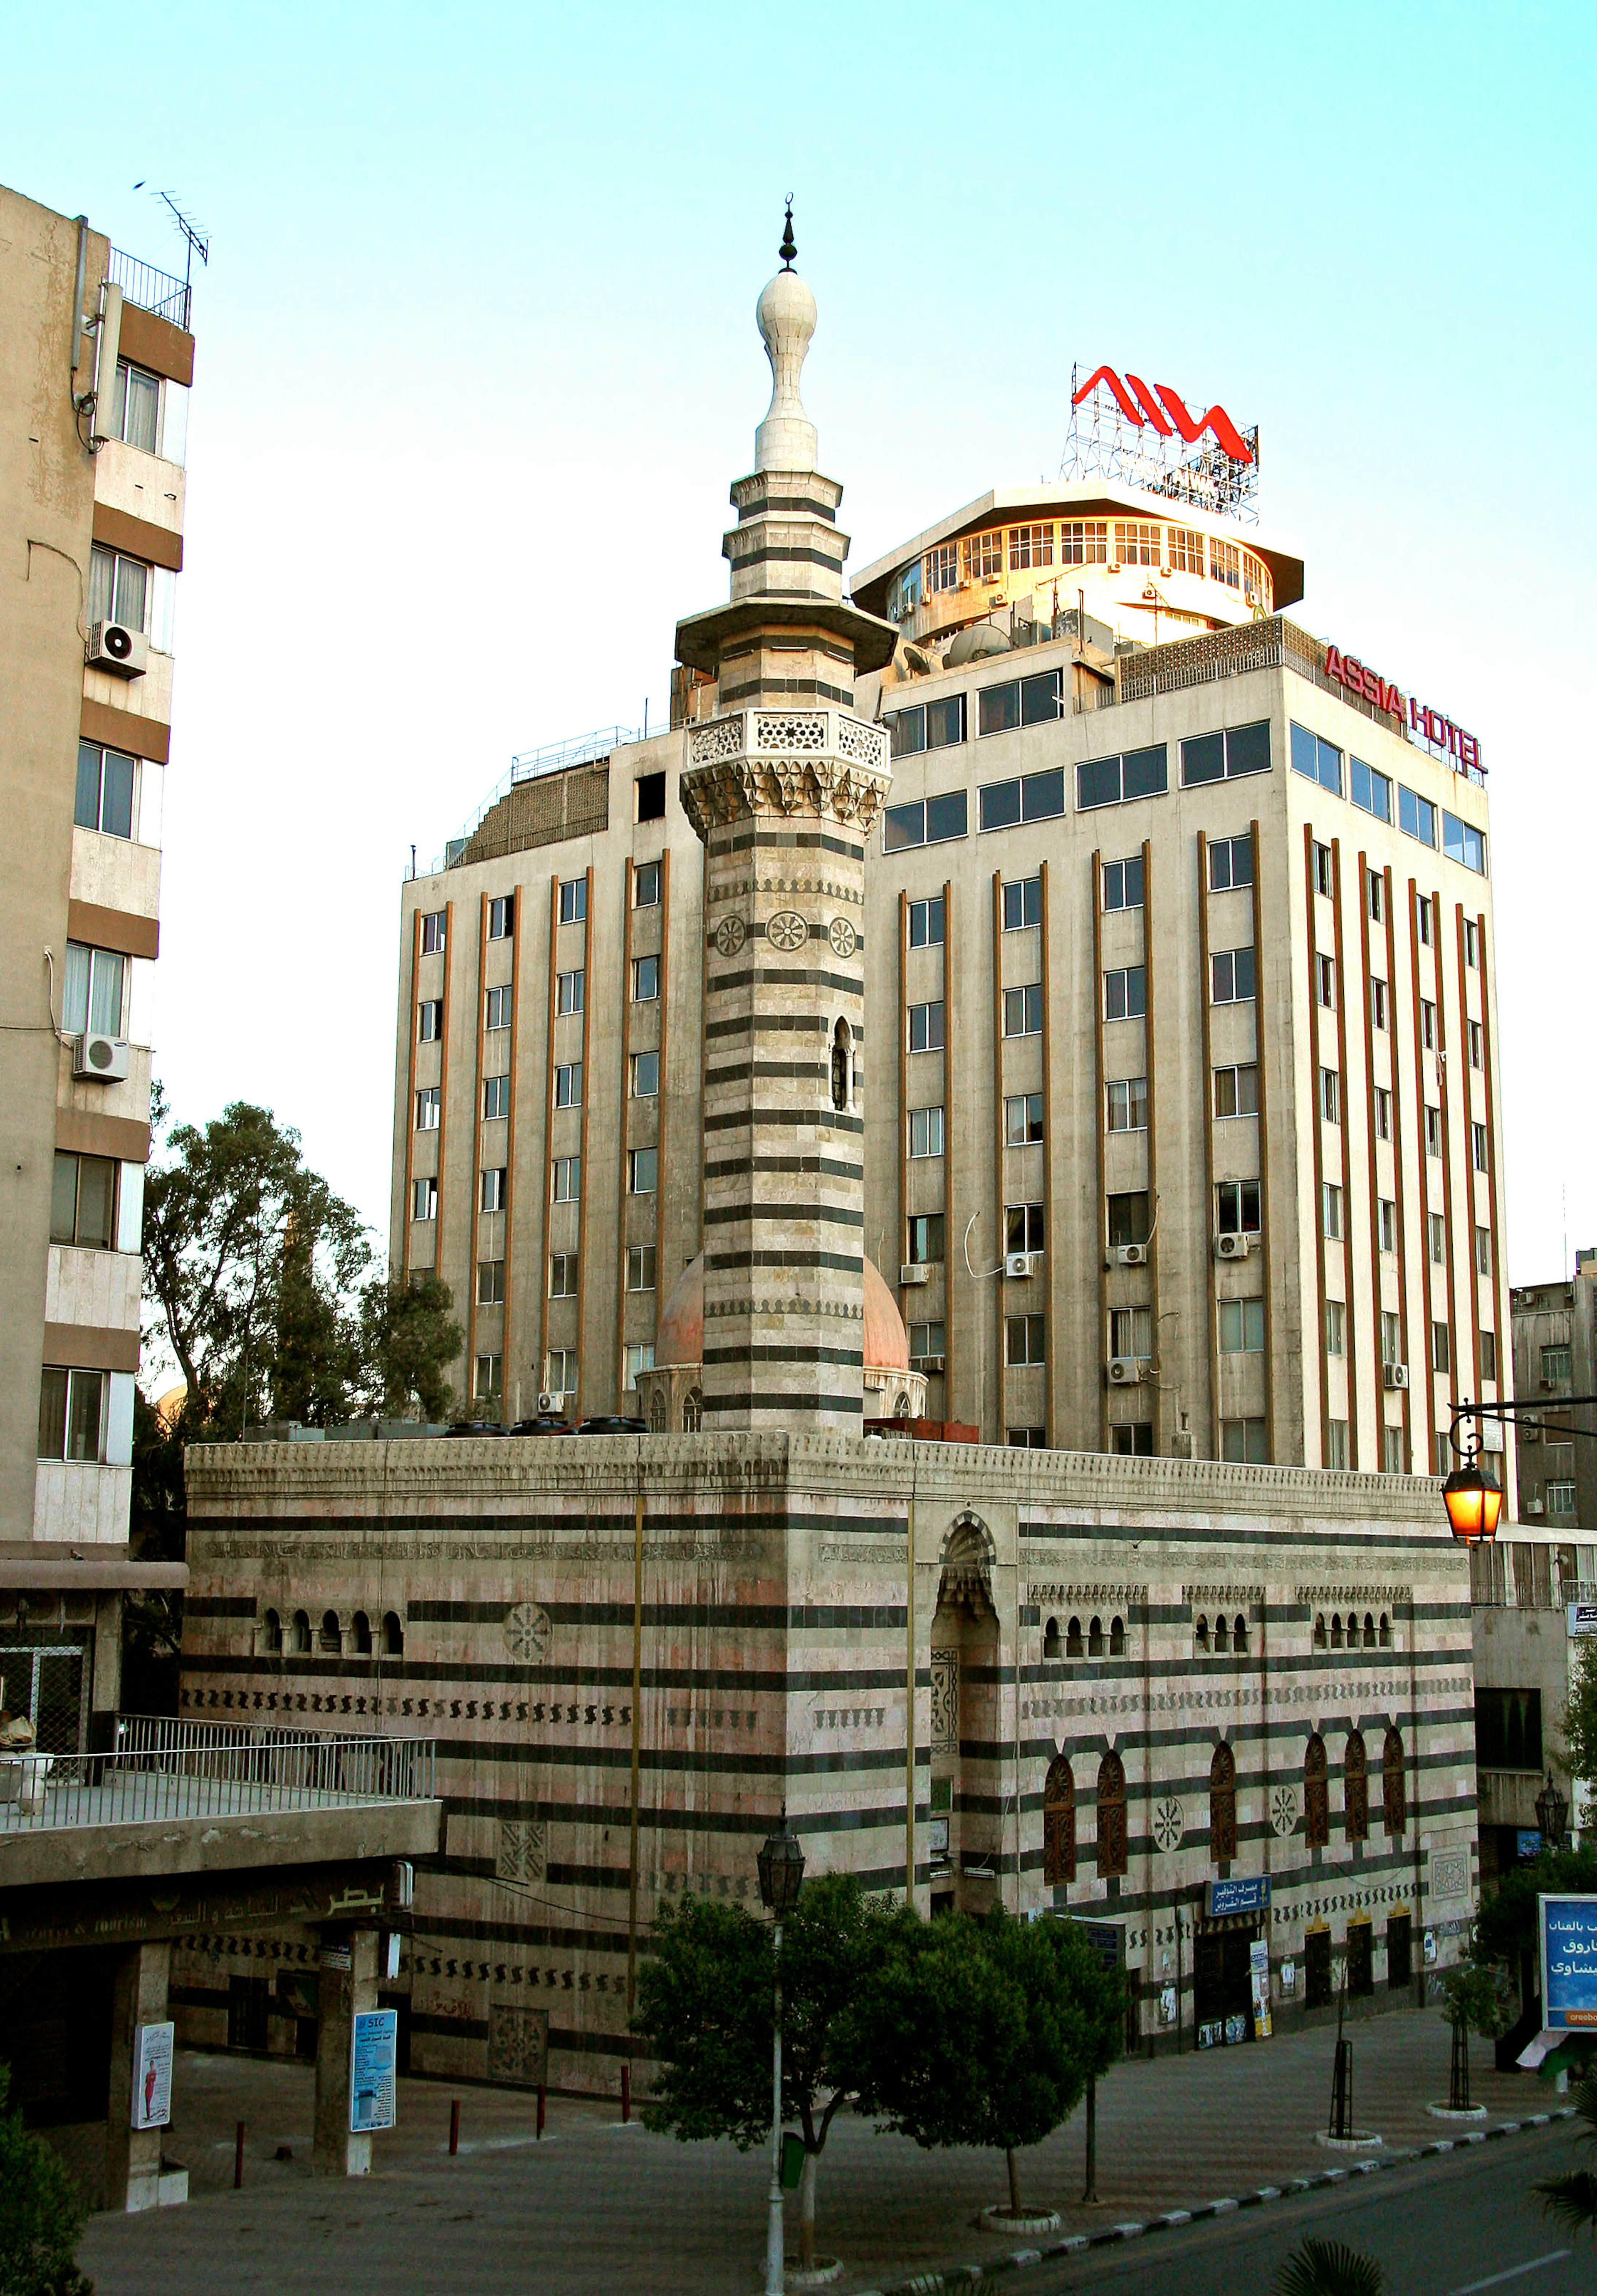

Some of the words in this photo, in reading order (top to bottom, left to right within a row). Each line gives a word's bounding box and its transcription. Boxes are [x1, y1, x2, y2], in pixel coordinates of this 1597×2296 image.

[1325, 645, 1406, 723] ASSIA
[1410, 698, 1488, 774] HOTEL
[1562, 1938, 1597, 1954] اروق
[368, 2017, 384, 2028] SIC
